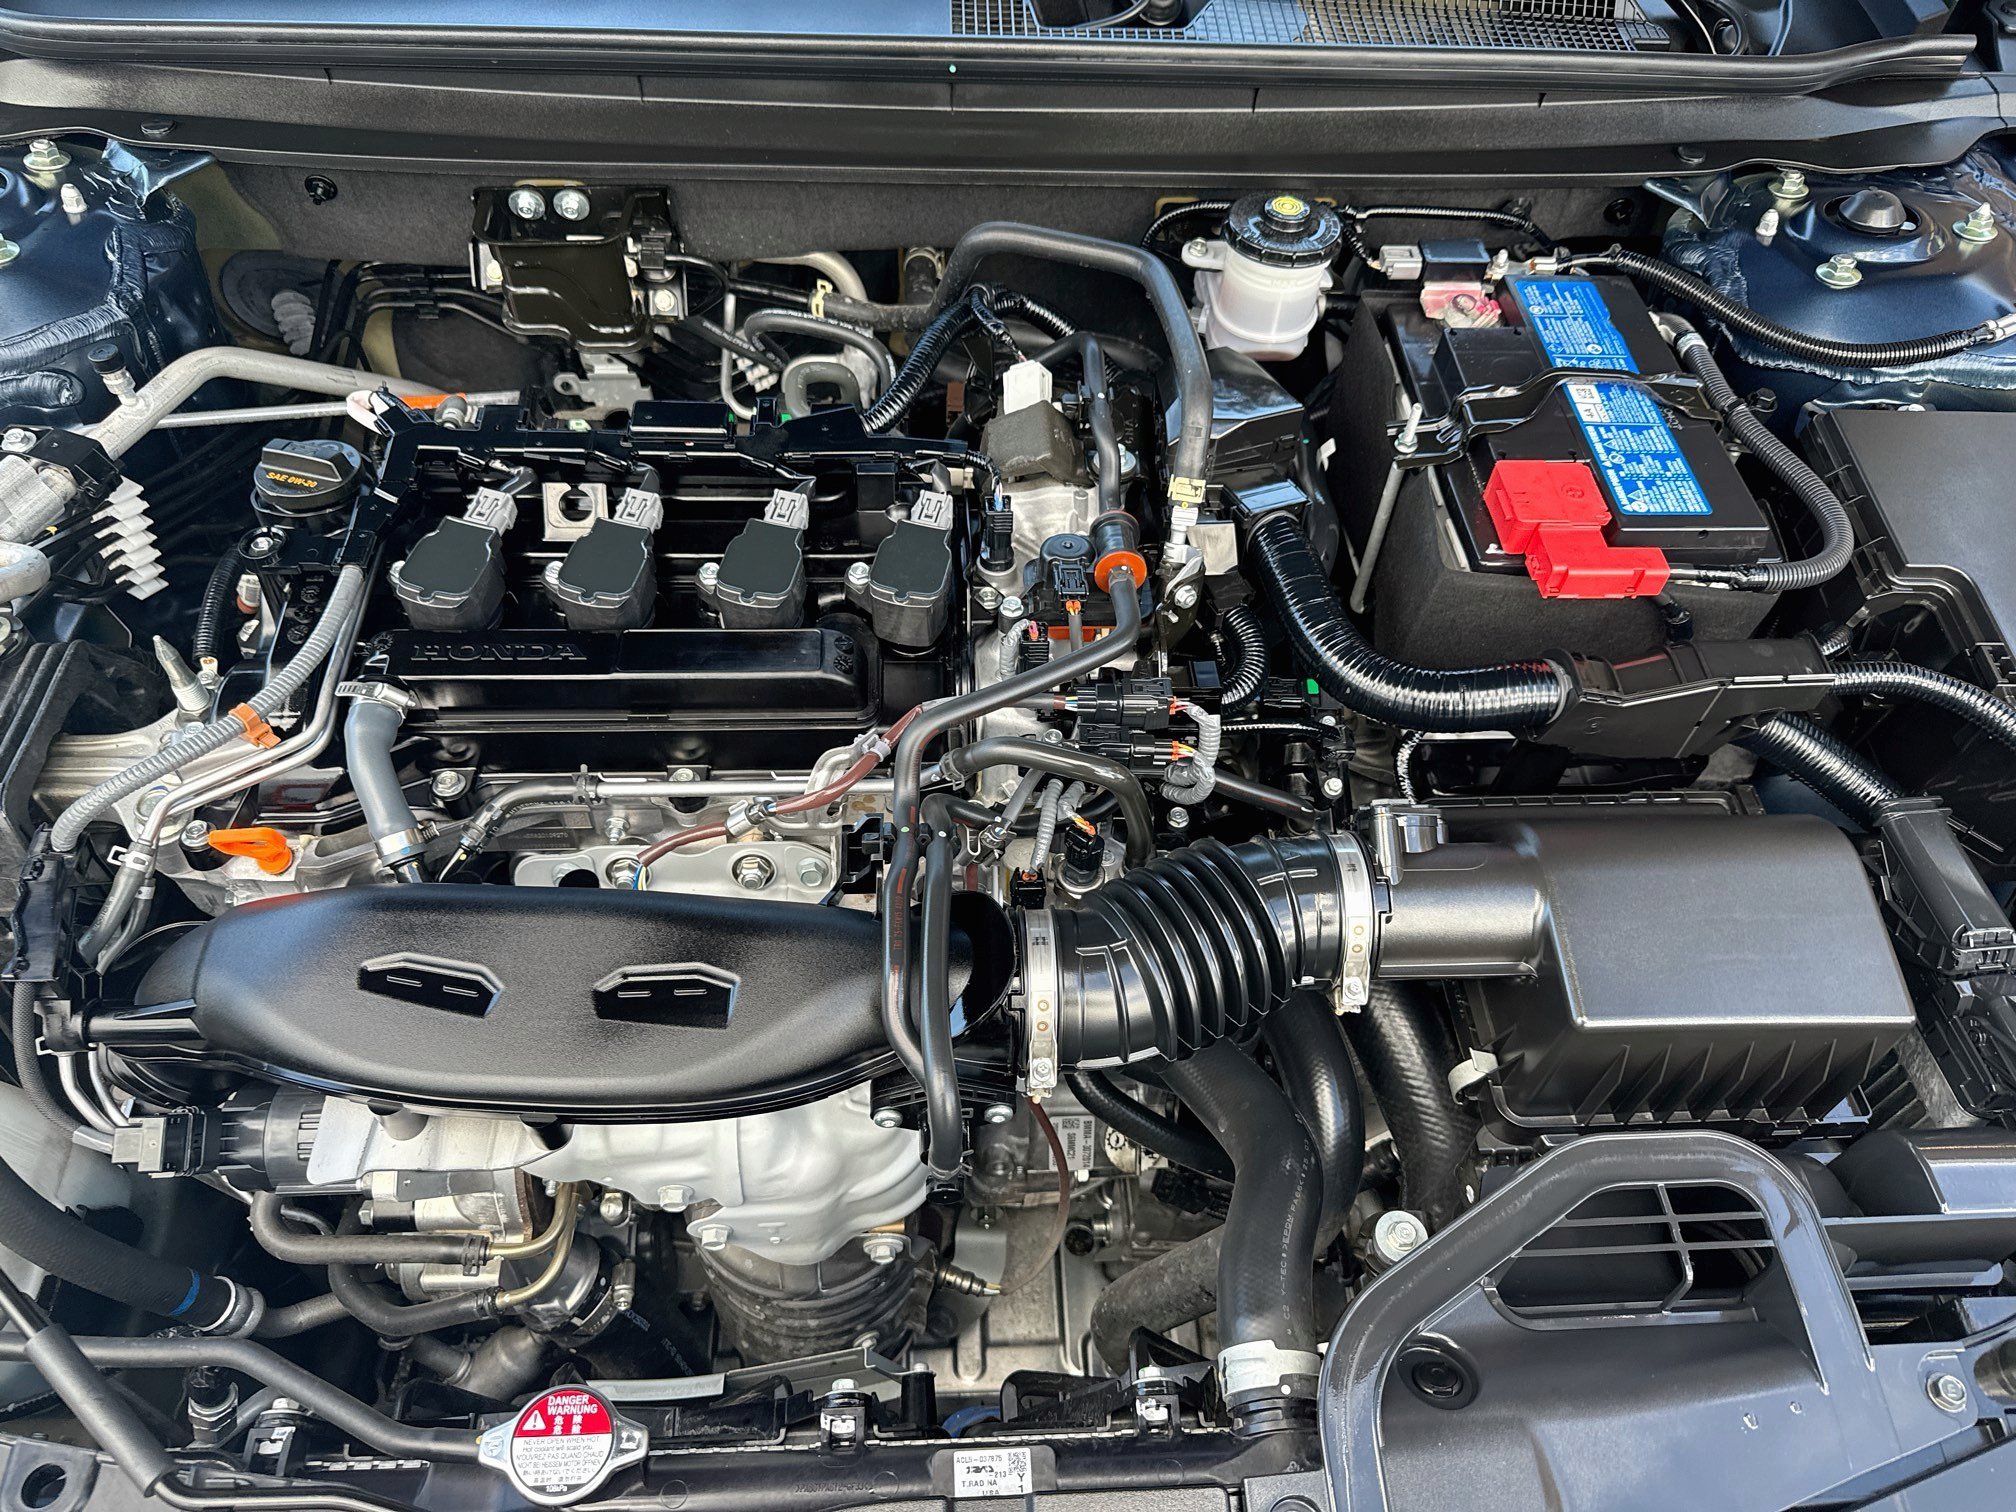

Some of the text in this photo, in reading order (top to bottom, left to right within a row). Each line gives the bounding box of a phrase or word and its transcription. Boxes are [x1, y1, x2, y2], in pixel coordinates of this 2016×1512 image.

[266, 472, 318, 488] SAE 0W-20
[411, 644, 587, 661] HONDA
[548, 1395, 590, 1406] DANGER
[547, 1404, 598, 1416] WARNUNG
[561, 1451, 582, 1459] QUAND
[583, 1450, 604, 1458] CHAUD
[564, 1459, 581, 1467] MOTOR
[1017, 1472, 1025, 1482] Y
[1018, 1484, 1024, 1493] 1
